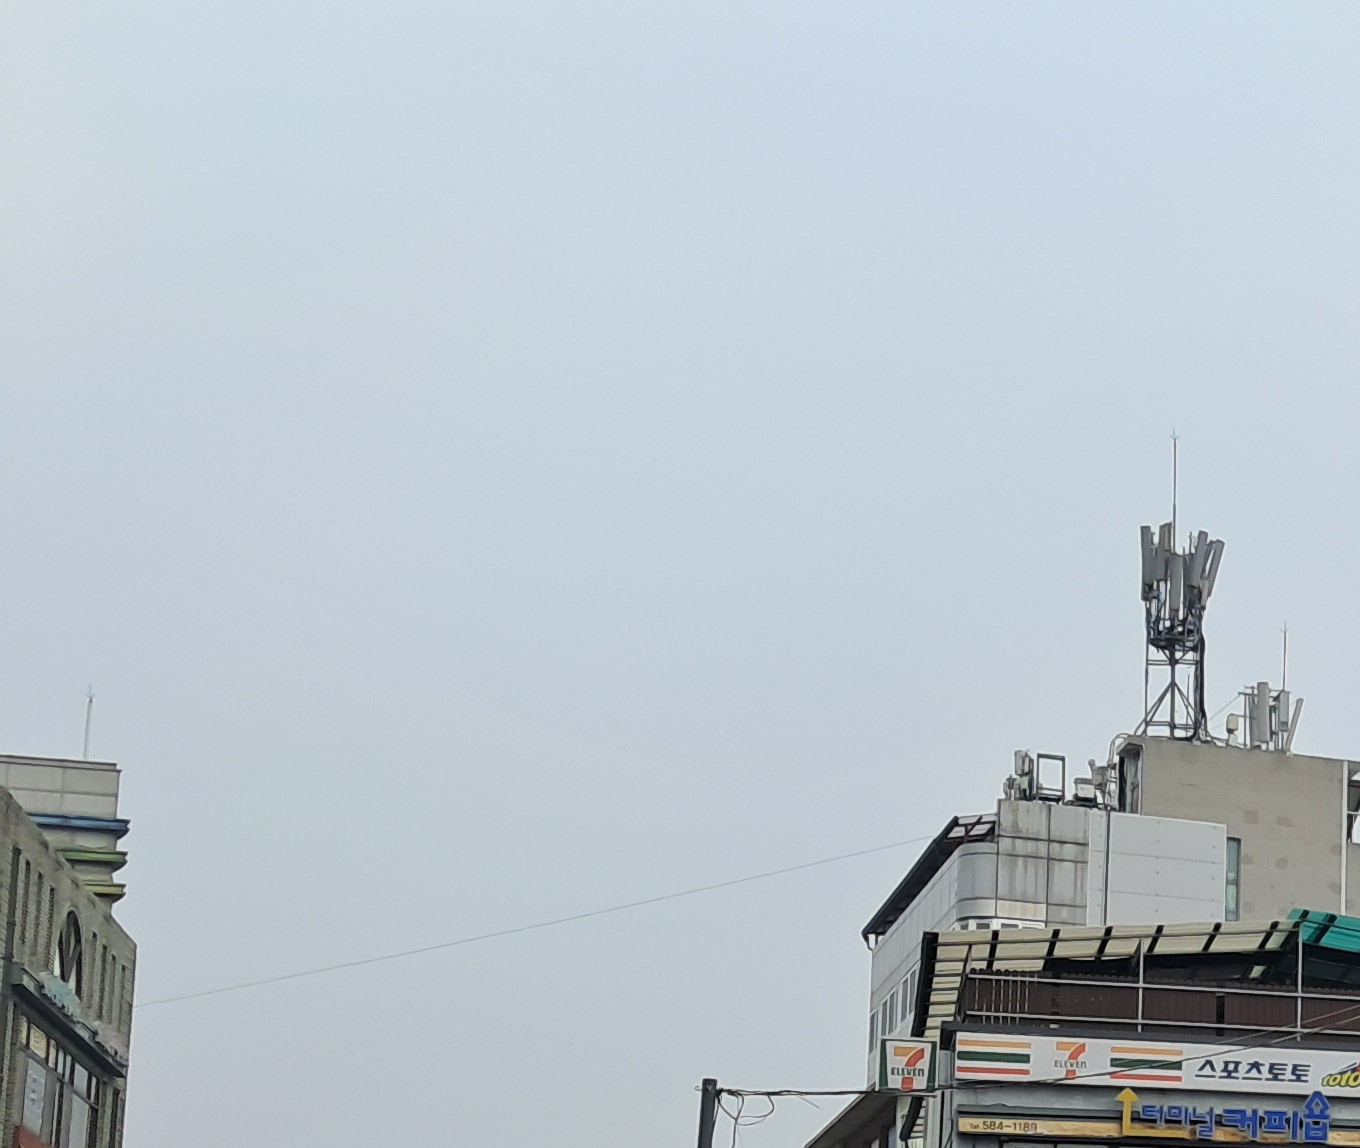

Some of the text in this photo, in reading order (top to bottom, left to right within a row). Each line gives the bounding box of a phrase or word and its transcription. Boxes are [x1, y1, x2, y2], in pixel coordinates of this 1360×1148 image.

[1194, 1058, 1312, 1084] 스포츠토토
[1139, 1090, 1332, 1143] 터미널 커피숍
